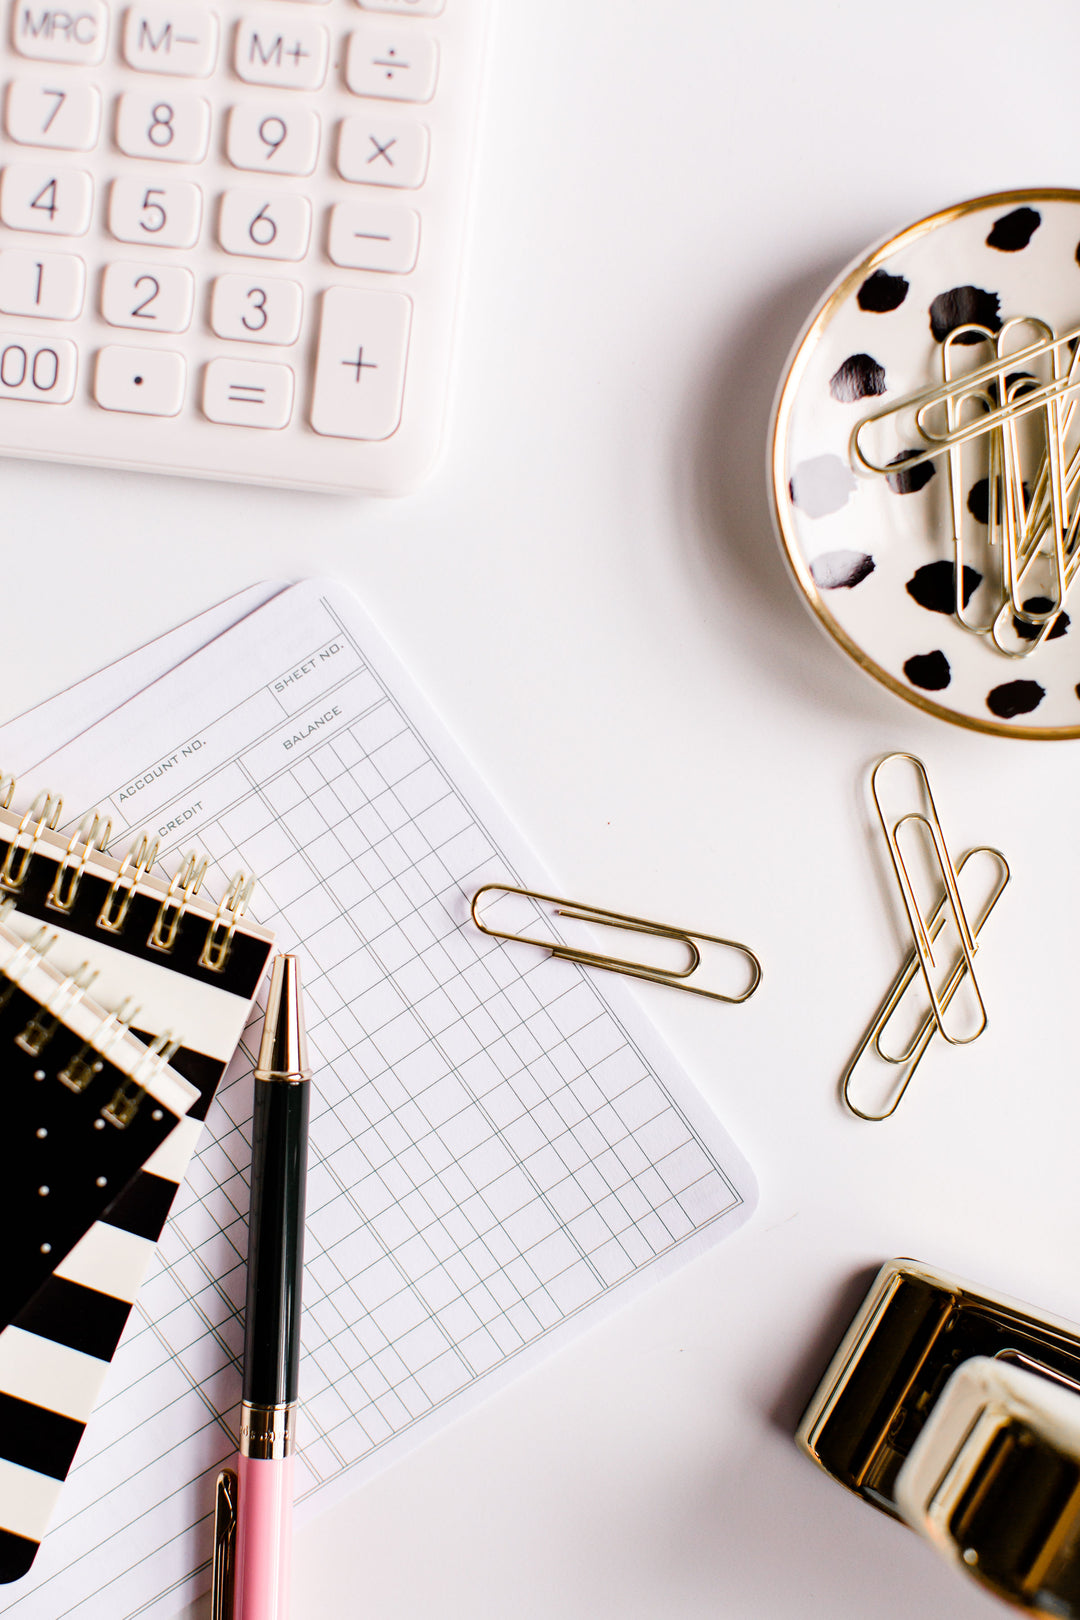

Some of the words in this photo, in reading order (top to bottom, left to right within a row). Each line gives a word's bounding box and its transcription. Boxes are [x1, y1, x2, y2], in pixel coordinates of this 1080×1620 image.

[22, 10, 98, 45] MRC
[249, 33, 311, 67] M+
[42, 90, 67, 134] 7
[148, 104, 174, 148] 8
[259, 117, 288, 160] 9
[30, 179, 58, 221] 4
[139, 189, 167, 233] 5
[248, 203, 277, 246] 6
[35, 262, 44, 305] 1
[131, 276, 160, 319] 2
[241, 288, 268, 331] 3
[0, 344, 60, 391] 00
[274, 659, 316, 693] SHEET
[320, 643, 345, 661] NO.
[283, 706, 342, 750] BALANCE
[118, 755, 179, 802] ACCOUNT
[182, 739, 206, 758] NO.
[158, 801, 204, 837] CREDIT
